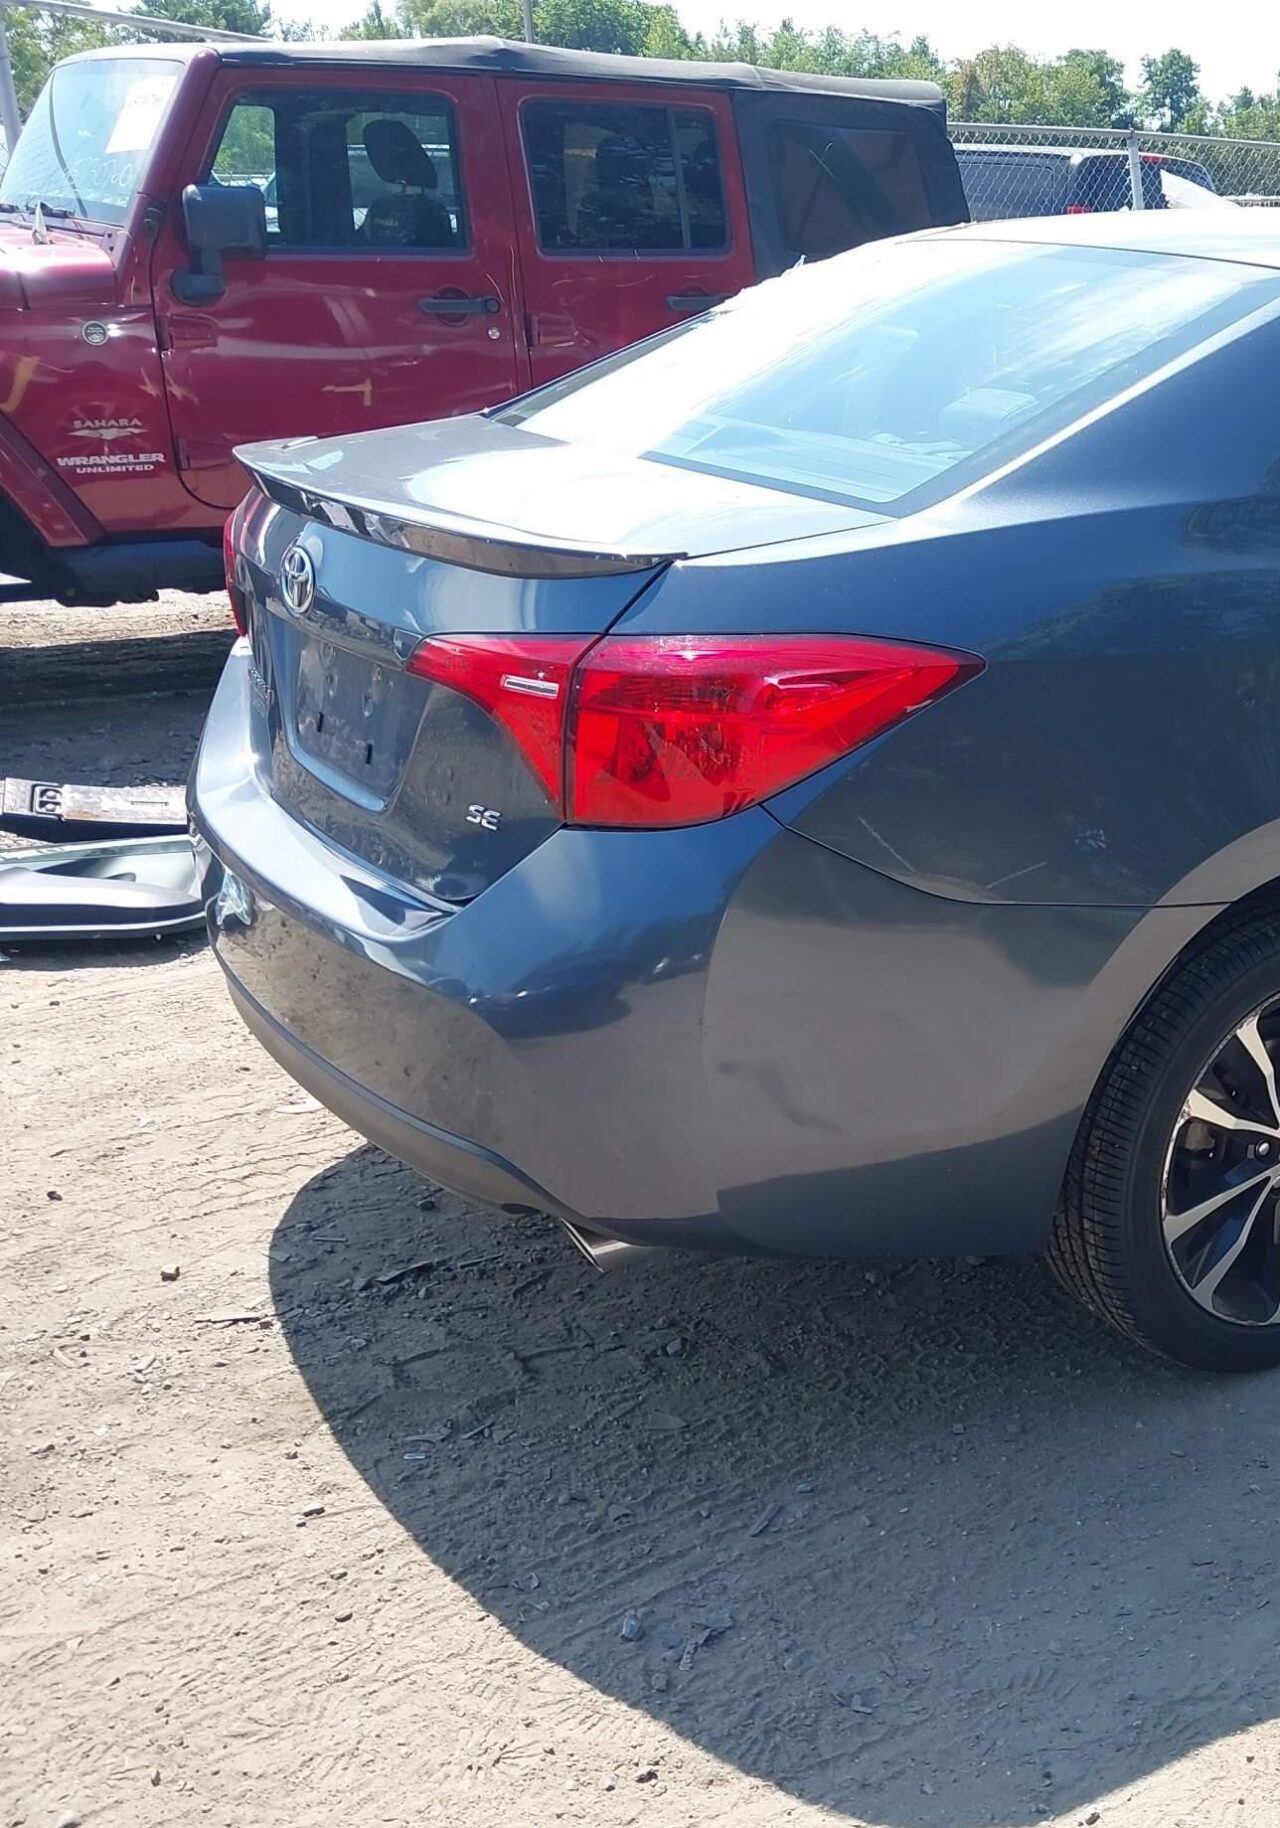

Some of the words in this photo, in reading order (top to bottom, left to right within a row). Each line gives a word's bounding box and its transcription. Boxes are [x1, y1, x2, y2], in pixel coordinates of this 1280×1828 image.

[73, 418, 142, 429] SAHARA
[56, 453, 166, 466] WRANGLER
[76, 464, 154, 474] UNLIMITED
[465, 804, 501, 831] SE
